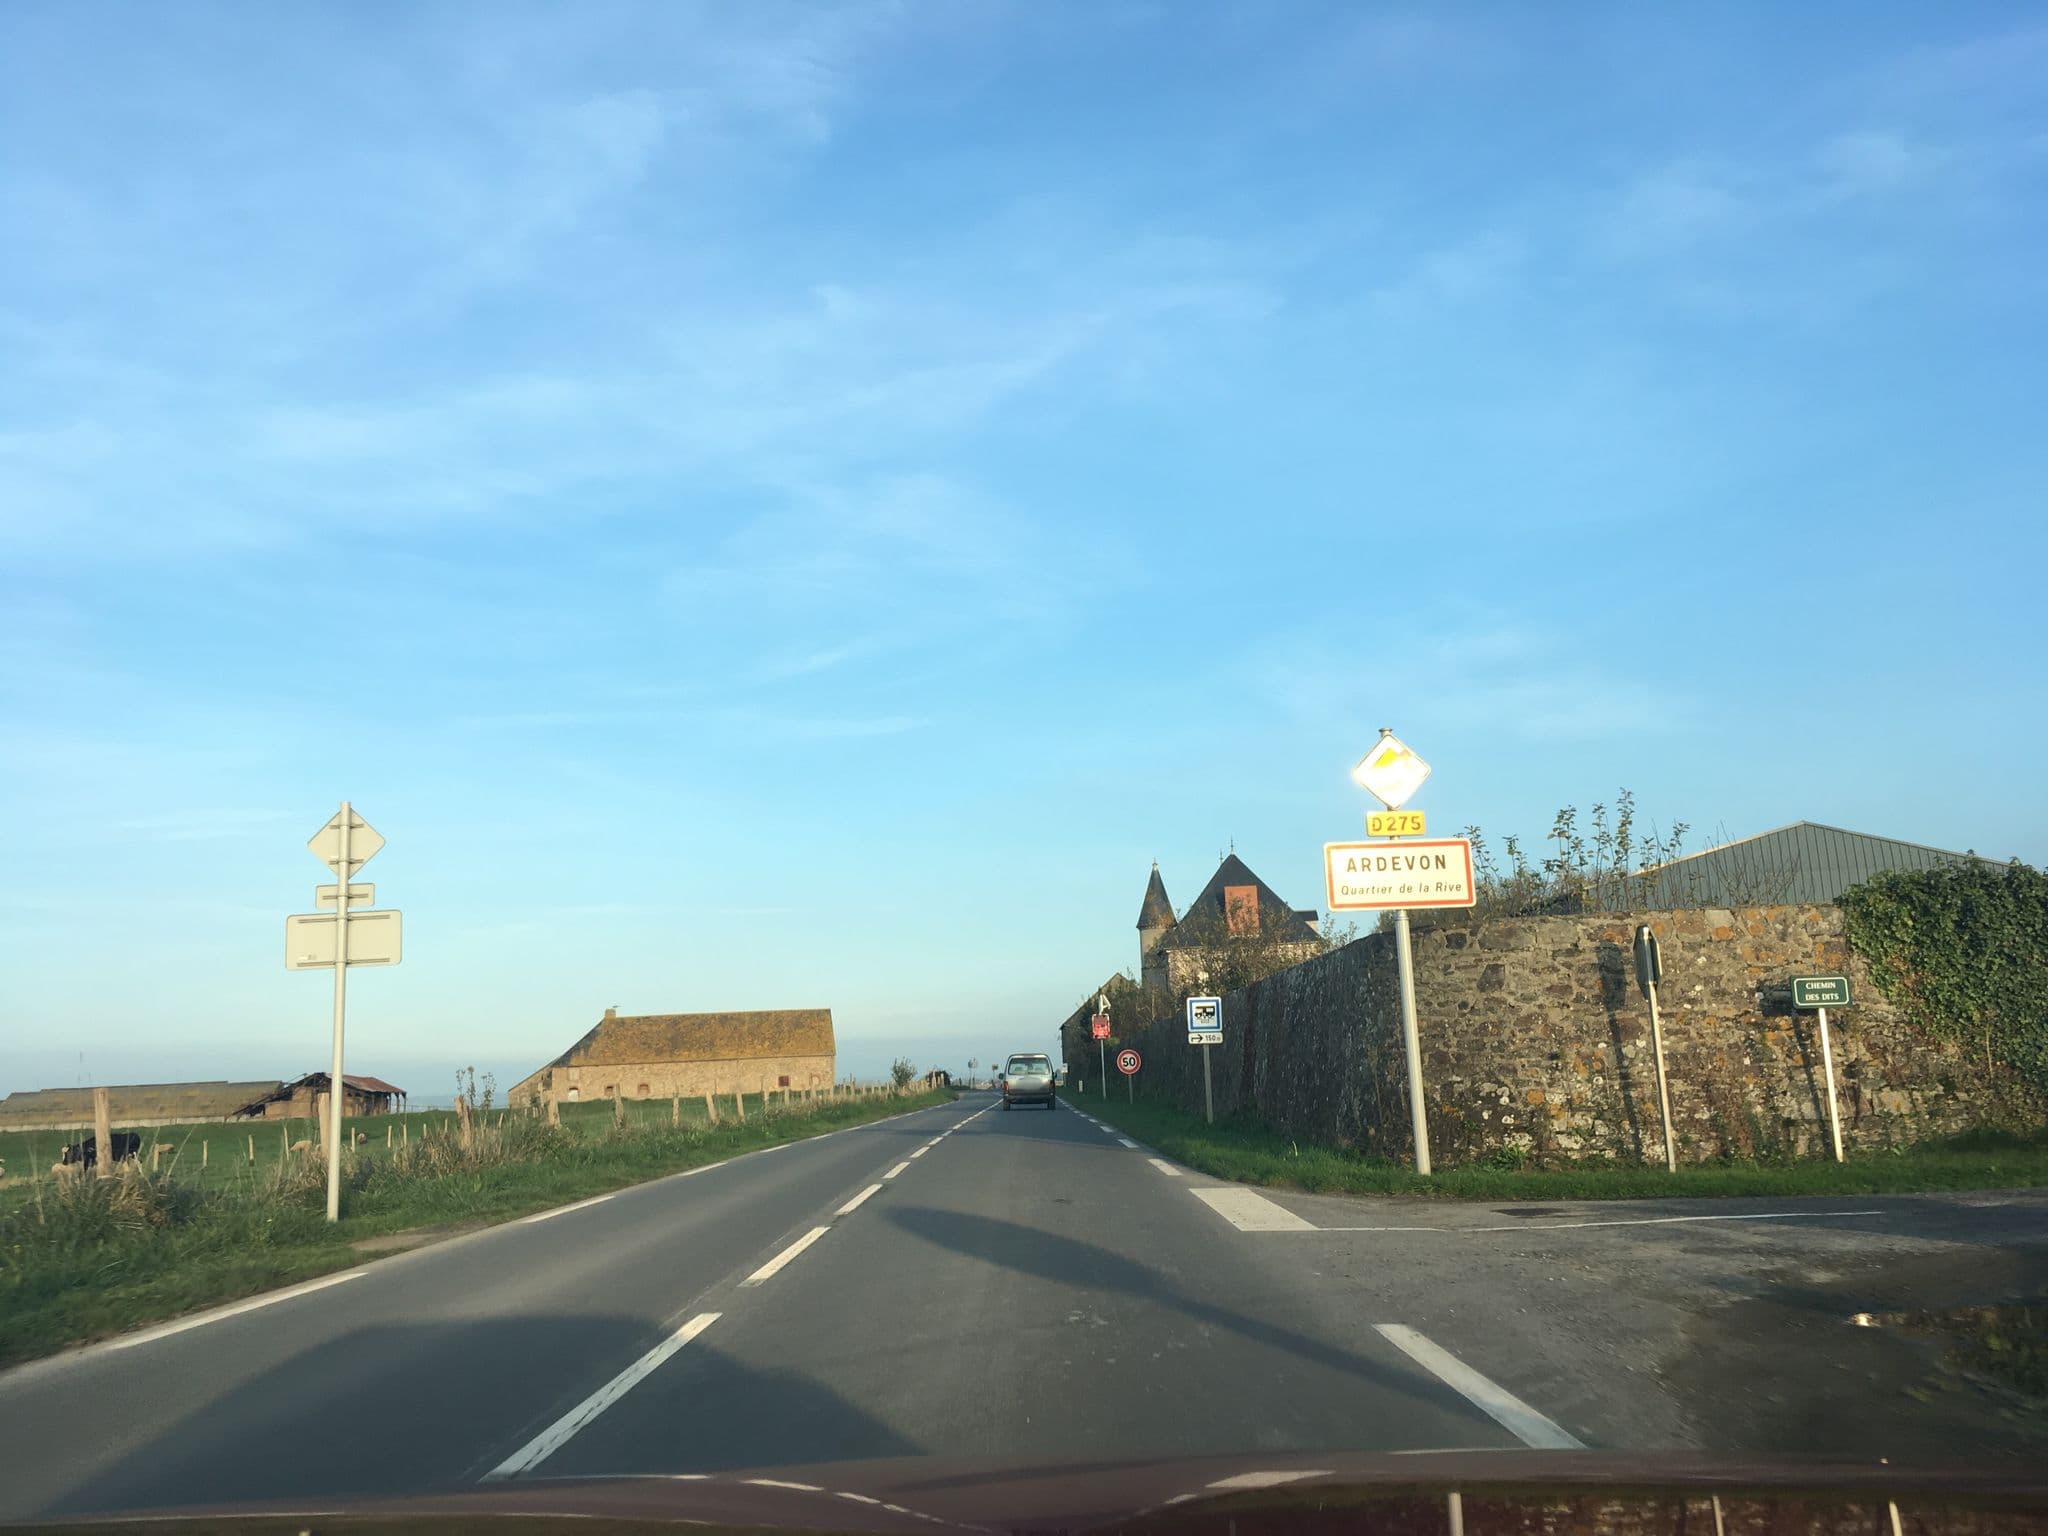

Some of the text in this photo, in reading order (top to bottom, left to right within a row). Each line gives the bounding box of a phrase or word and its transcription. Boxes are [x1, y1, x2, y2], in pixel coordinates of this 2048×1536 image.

[1347, 854, 1446, 872] ARDEVON
[1341, 882, 1462, 896] Quartier de la Rive
[1805, 993, 1839, 1001] DES DITS
[1122, 1056, 1136, 1067] 50
